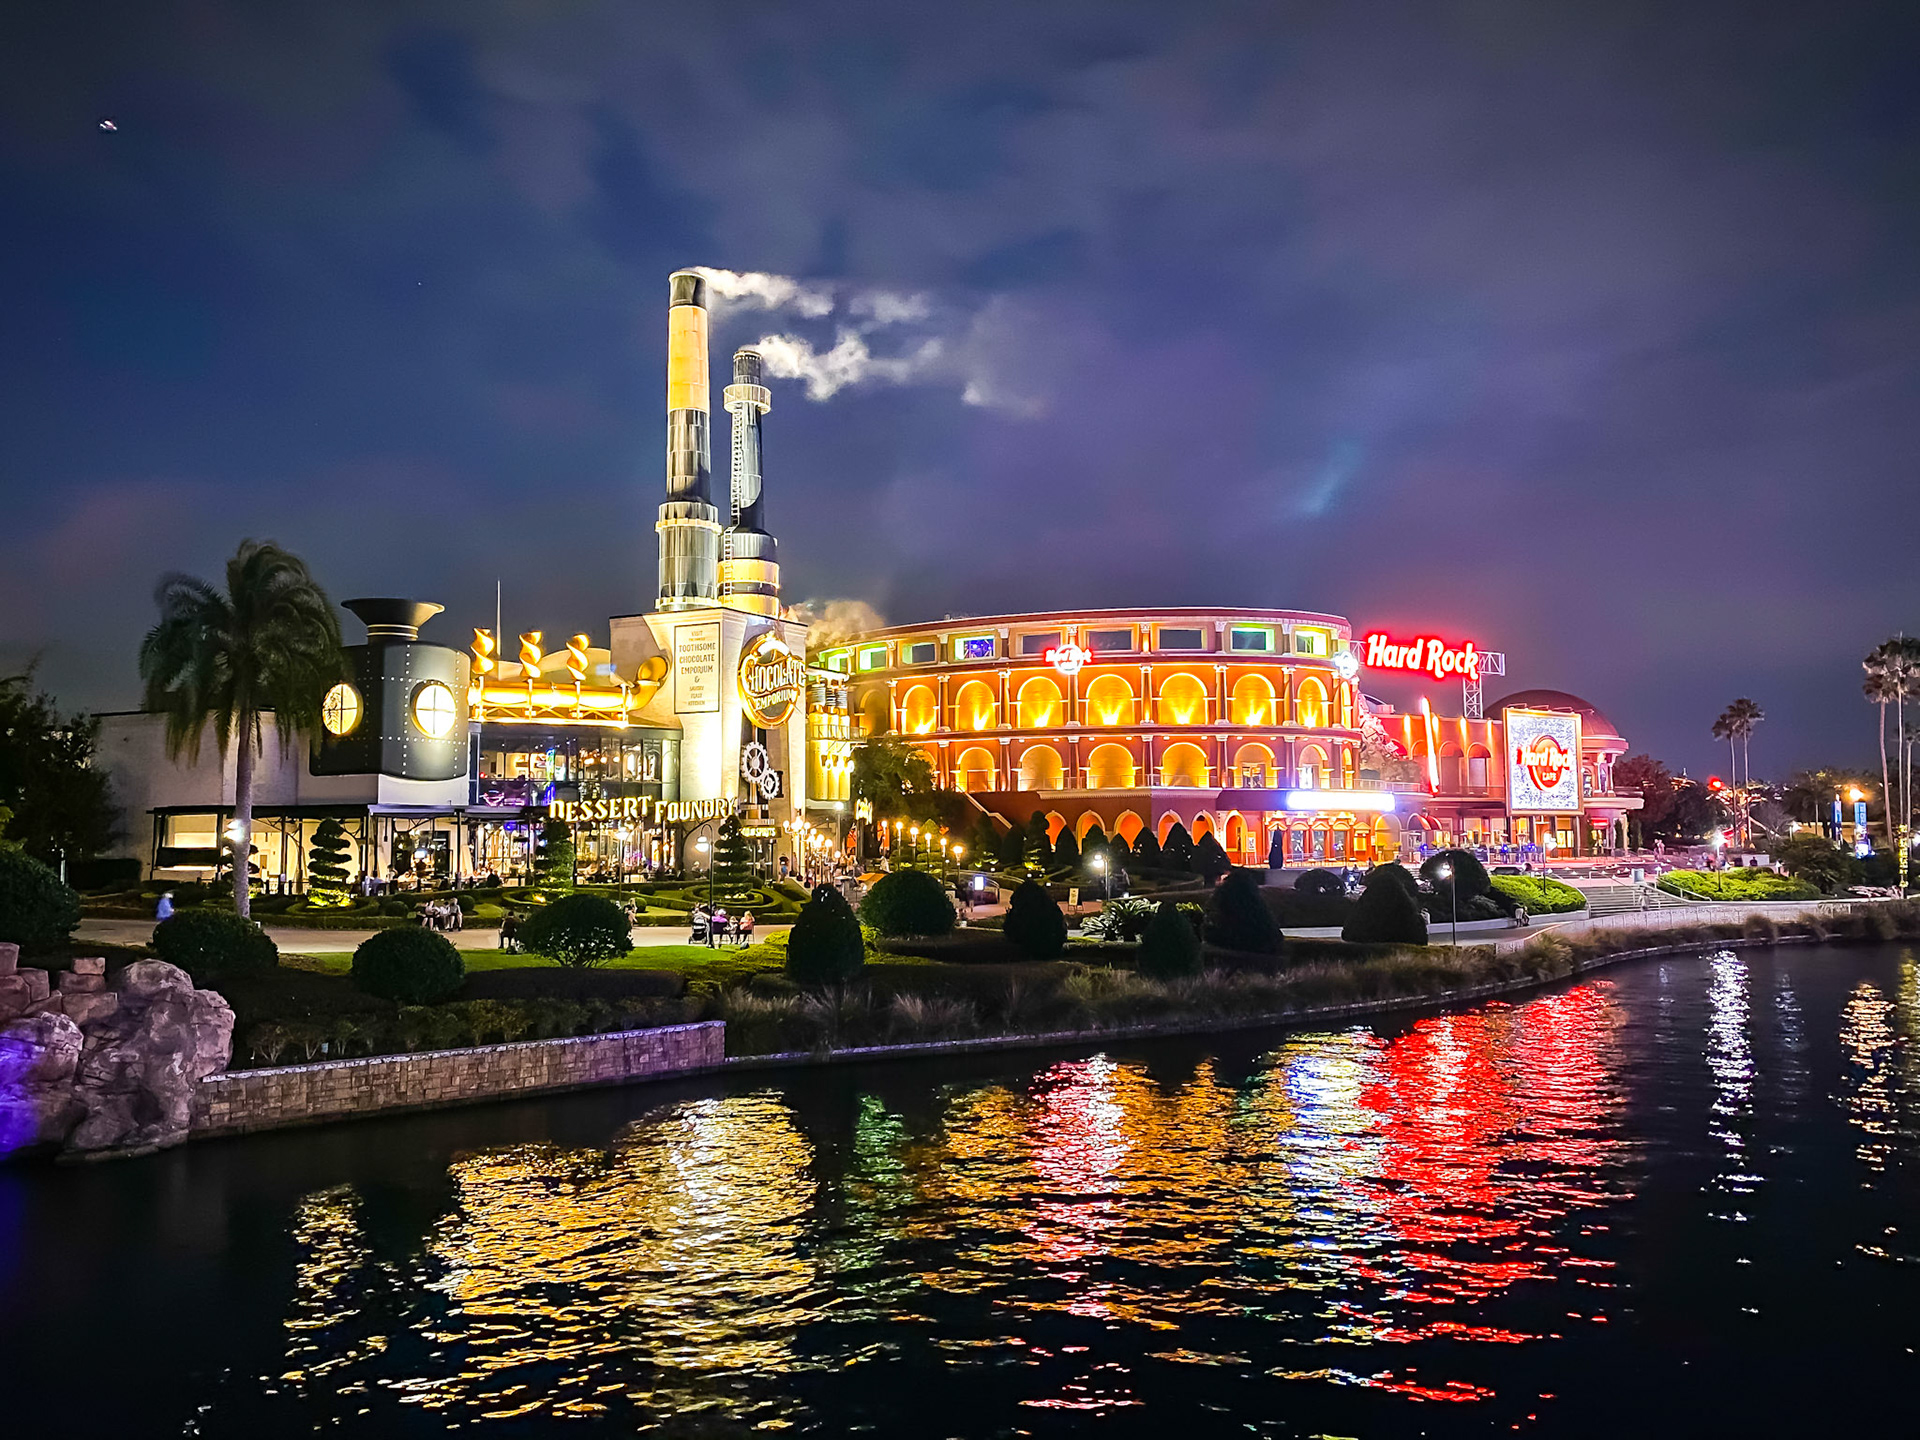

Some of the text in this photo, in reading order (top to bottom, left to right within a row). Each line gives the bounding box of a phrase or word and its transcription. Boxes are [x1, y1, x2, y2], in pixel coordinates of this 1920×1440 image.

[678, 642, 716, 653] TOOTHSOME
[1367, 634, 1479, 680] Hard Rock
[679, 653, 715, 664] CHOCOLATE
[680, 665, 714, 675] EMPORIUM
[740, 655, 806, 697] CHOCOLATE
[755, 688, 794, 710] EMPORIUM
[1521, 745, 1548, 766] Hard
[549, 795, 737, 824] DESSERT FOUNDRY
